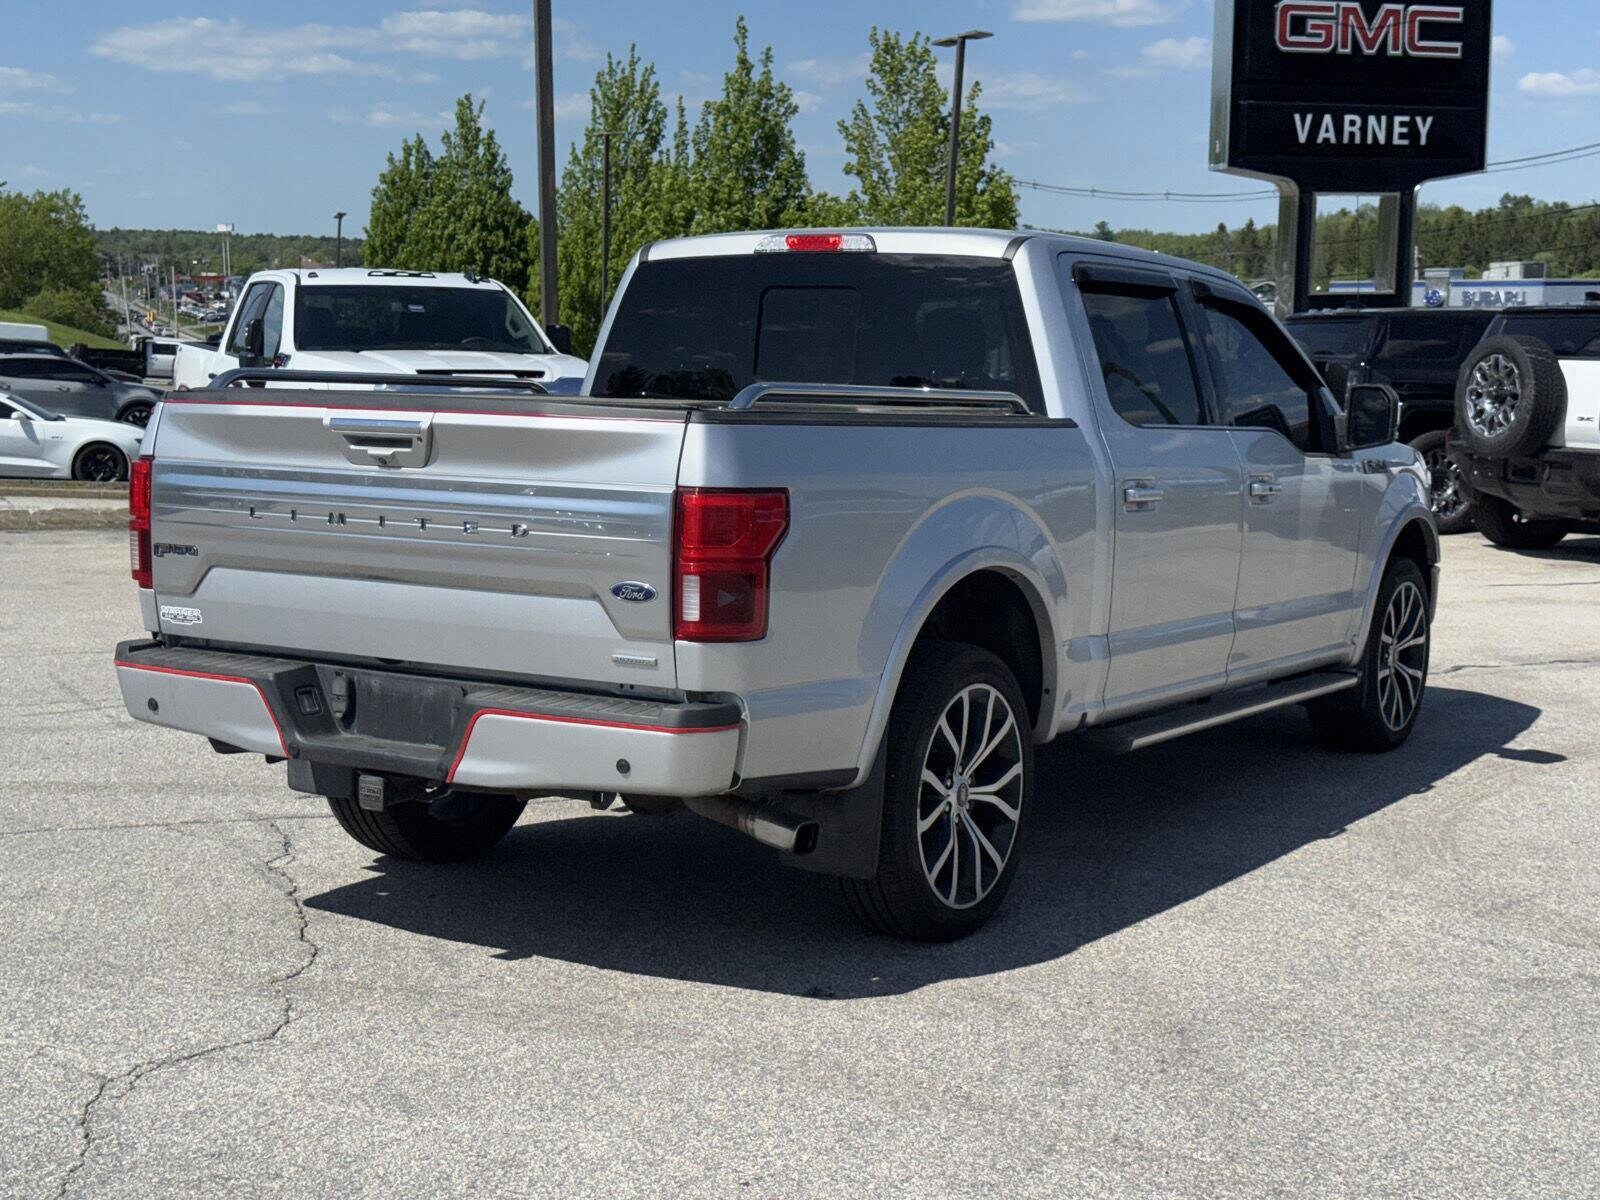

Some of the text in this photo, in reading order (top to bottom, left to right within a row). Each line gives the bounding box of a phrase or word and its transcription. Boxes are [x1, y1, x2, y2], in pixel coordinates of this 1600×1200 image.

[1275, 0, 1464, 58] GMC
[1293, 113, 1434, 146] VARNEY
[249, 505, 530, 538] LIMITED
[619, 585, 646, 600] Ford
